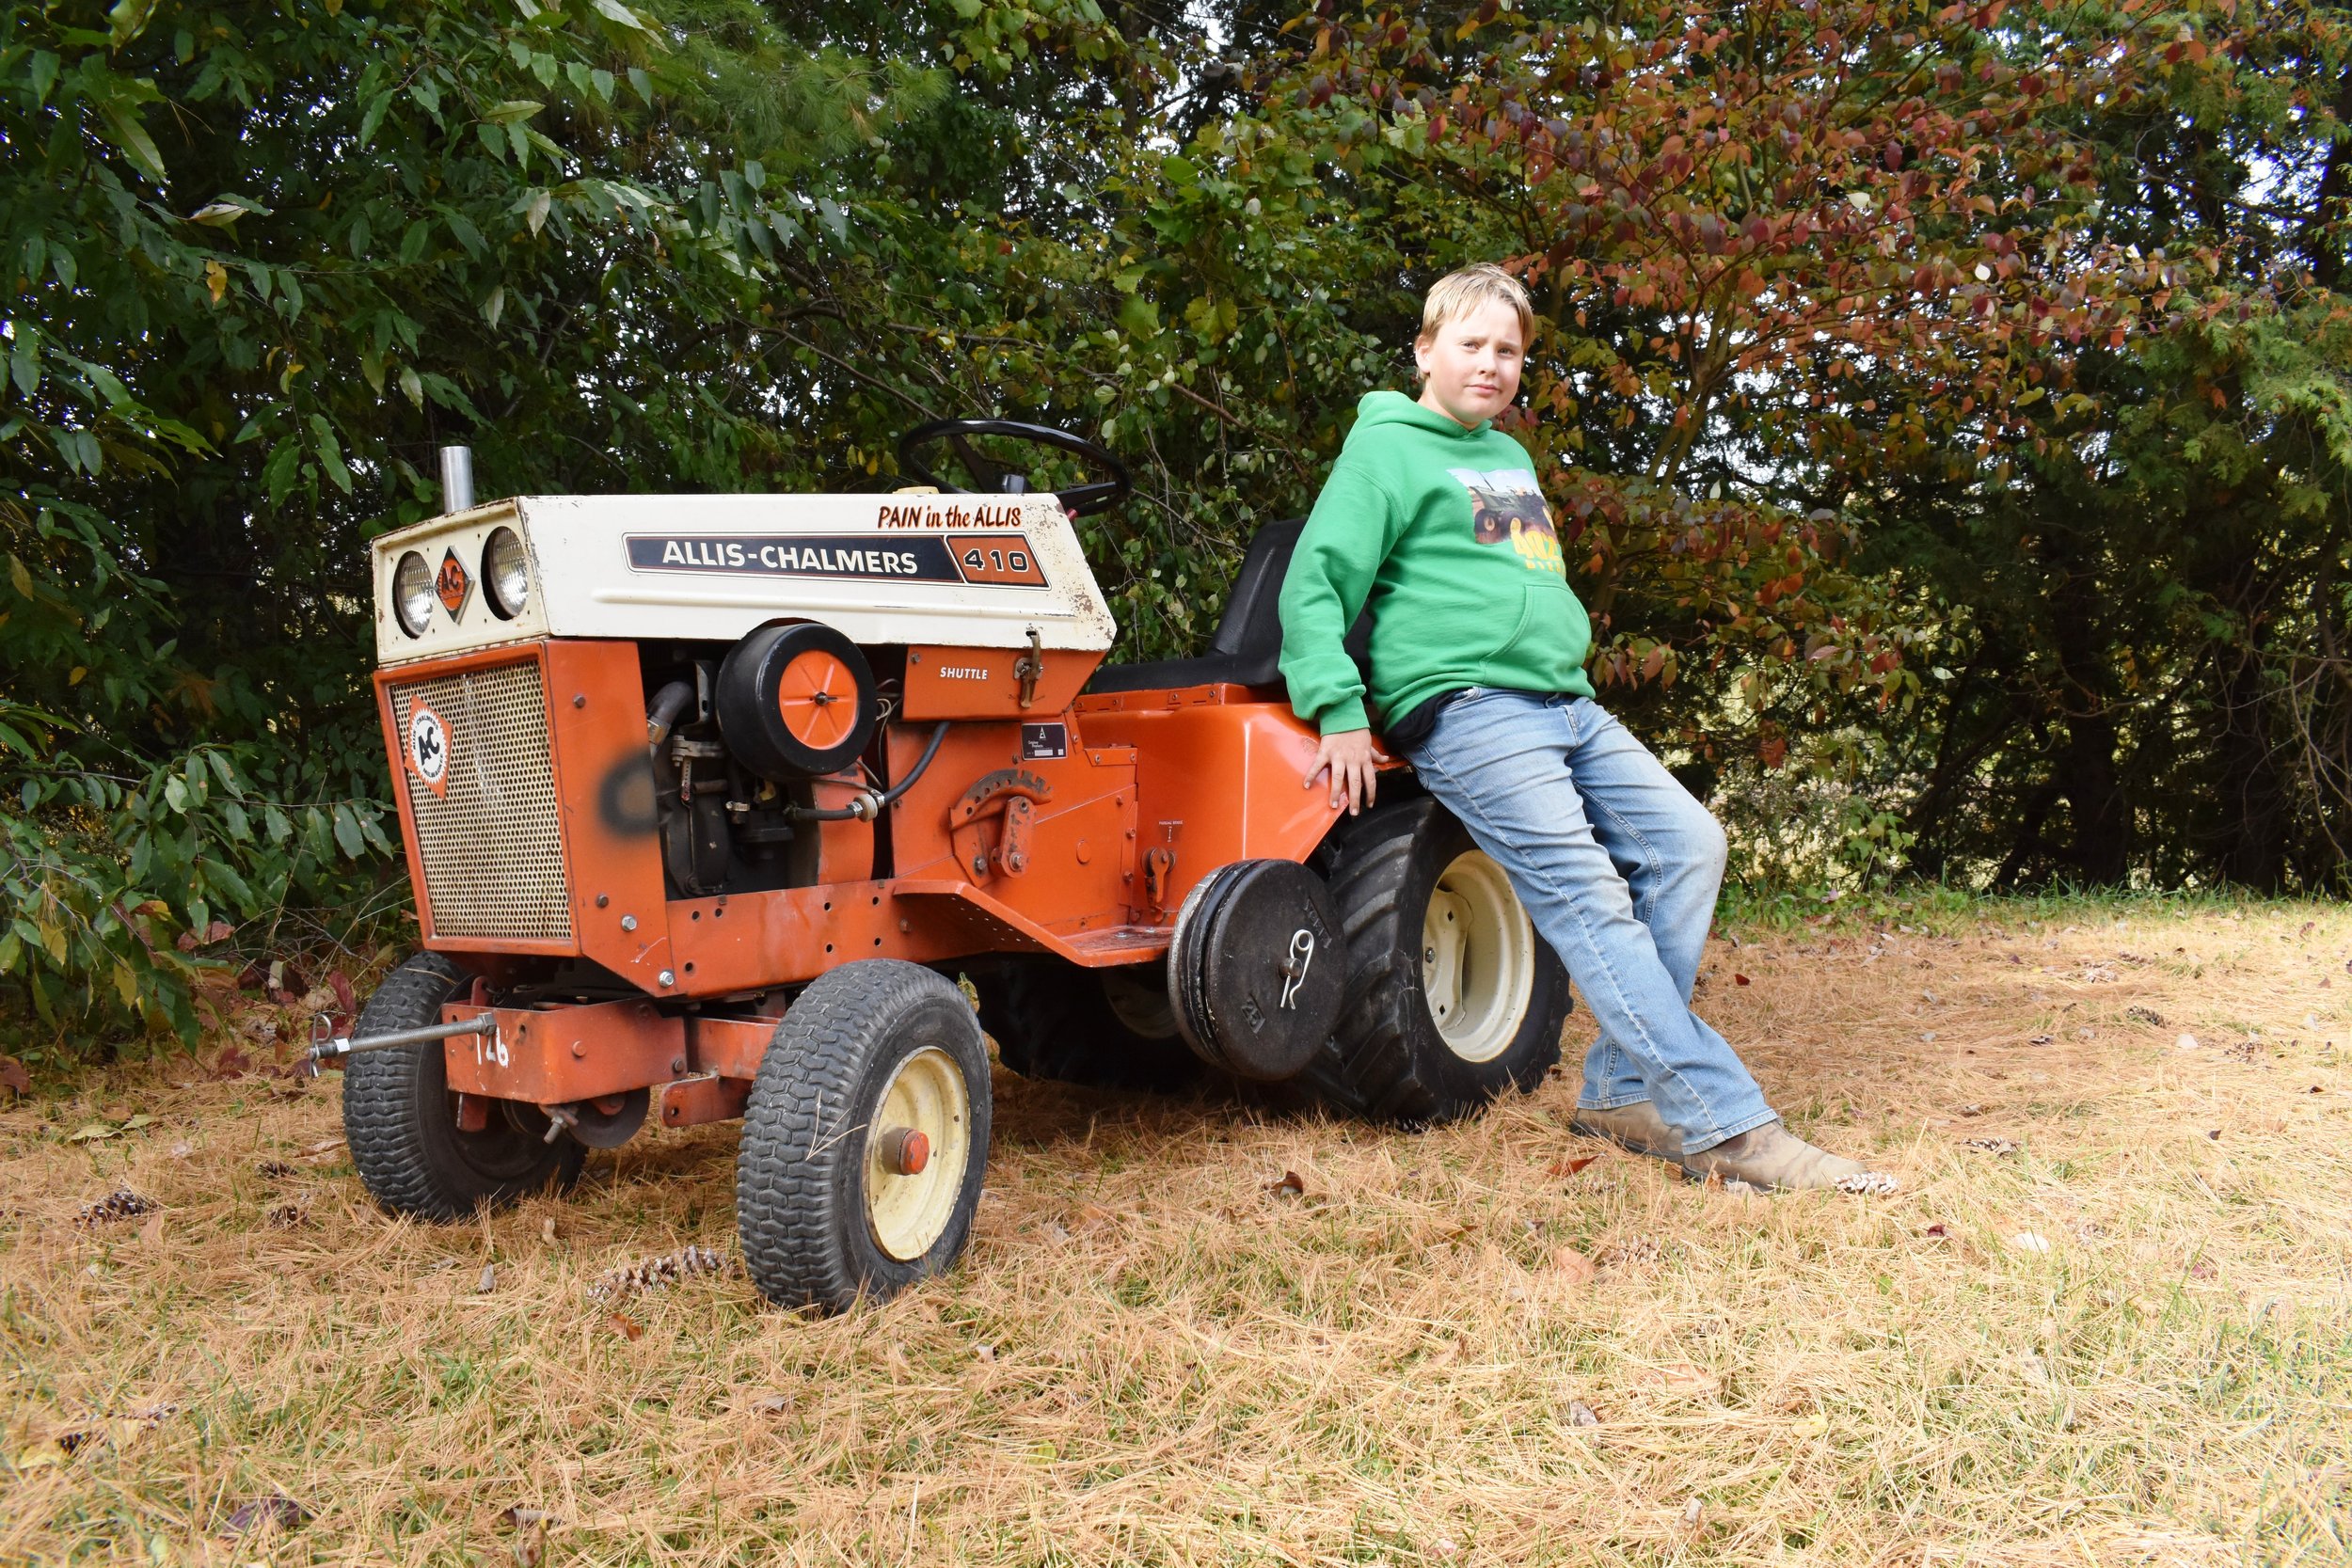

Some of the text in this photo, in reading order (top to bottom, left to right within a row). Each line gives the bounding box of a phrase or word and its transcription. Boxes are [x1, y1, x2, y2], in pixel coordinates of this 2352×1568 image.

[878, 505, 1022, 529] PAIN in the ALLIS
[662, 541, 918, 575] ALLIS-CHALMERS
[963, 548, 1029, 572] 410
[442, 564, 461, 593] AC
[940, 666, 988, 680] SHUTTLE
[419, 726, 440, 766] AC
